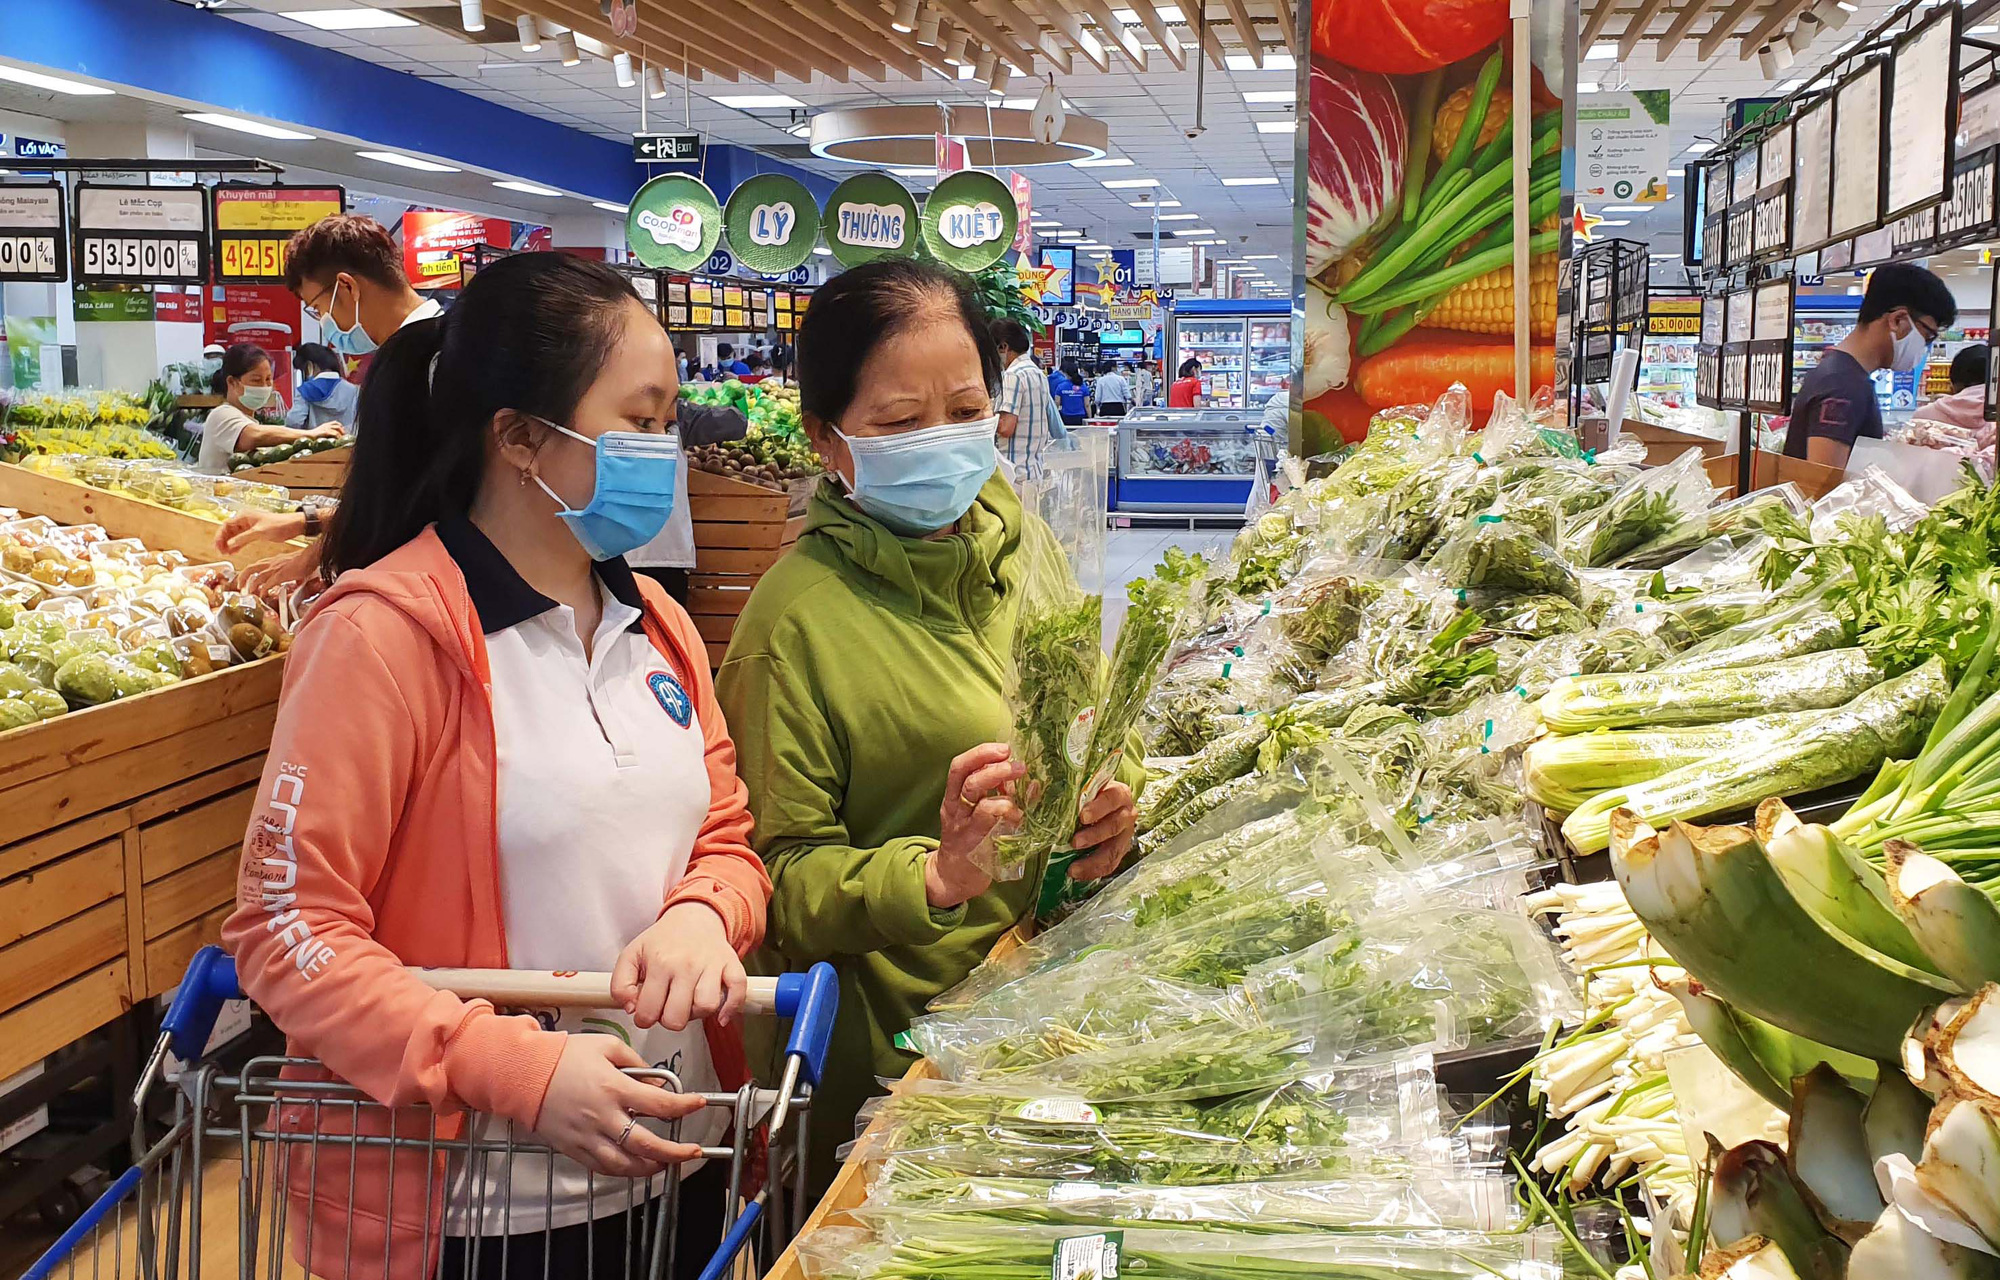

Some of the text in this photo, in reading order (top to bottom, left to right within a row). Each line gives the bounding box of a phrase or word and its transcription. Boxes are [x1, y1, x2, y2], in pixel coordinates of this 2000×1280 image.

[20, 141, 36, 154] LỐI
[677, 143, 692, 152] EXIT
[17, 197, 49, 206] Malaysia
[756, 204, 789, 240] LÝ
[840, 206, 901, 243] THƯỜNG
[950, 207, 1000, 243] KIỆT
[88, 243, 174, 268] 53.500
[454, 261, 458, 270] 1
[709, 256, 729, 270] 02
[789, 268, 807, 282] 04
[1115, 268, 1131, 283] 01
[1650, 320, 1692, 331] 65.000
[280, 760, 309, 778] CYC
[301, 945, 337, 982] ITA
